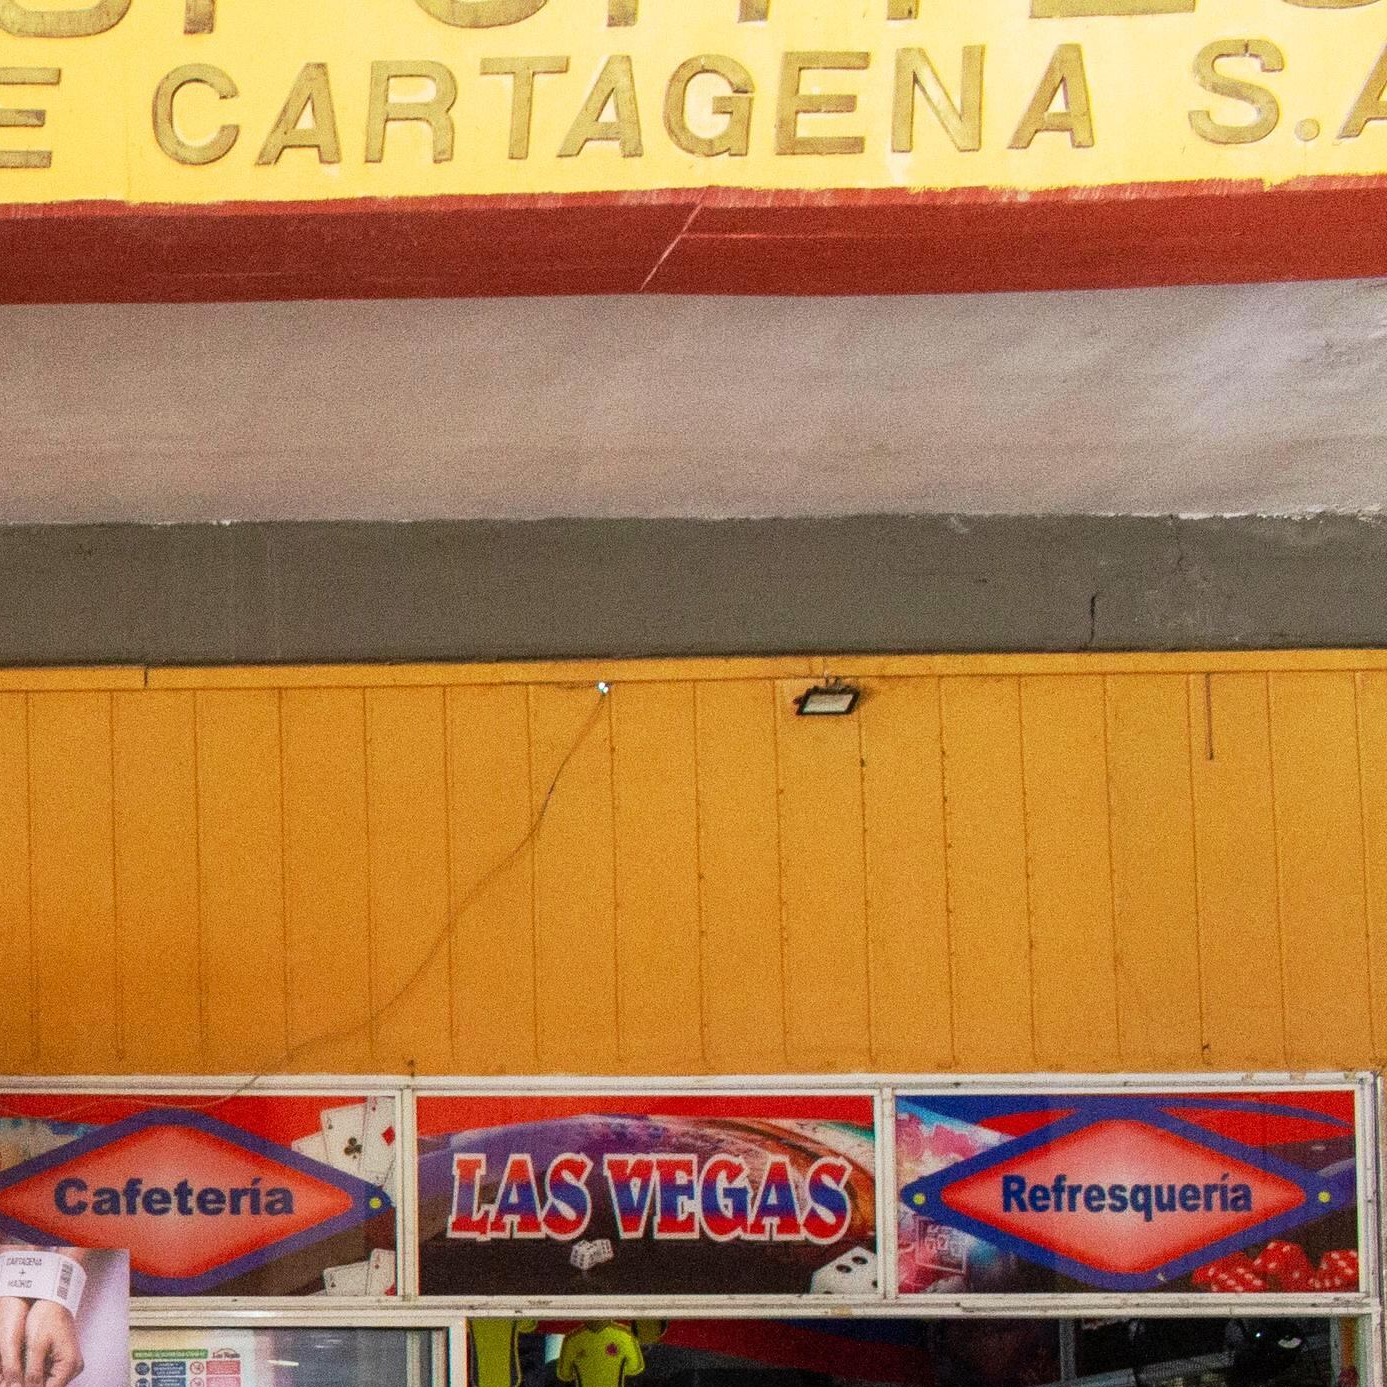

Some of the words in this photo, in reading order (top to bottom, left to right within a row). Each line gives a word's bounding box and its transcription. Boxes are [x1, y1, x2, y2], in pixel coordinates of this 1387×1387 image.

[150, 43, 1098, 167] CARTAGENA
[53, 1175, 294, 1216] Cafetería
[448, 1153, 595, 1241] LAS
[603, 1152, 854, 1244] VEGAS
[1001, 1172, 1253, 1222] Refresquería
